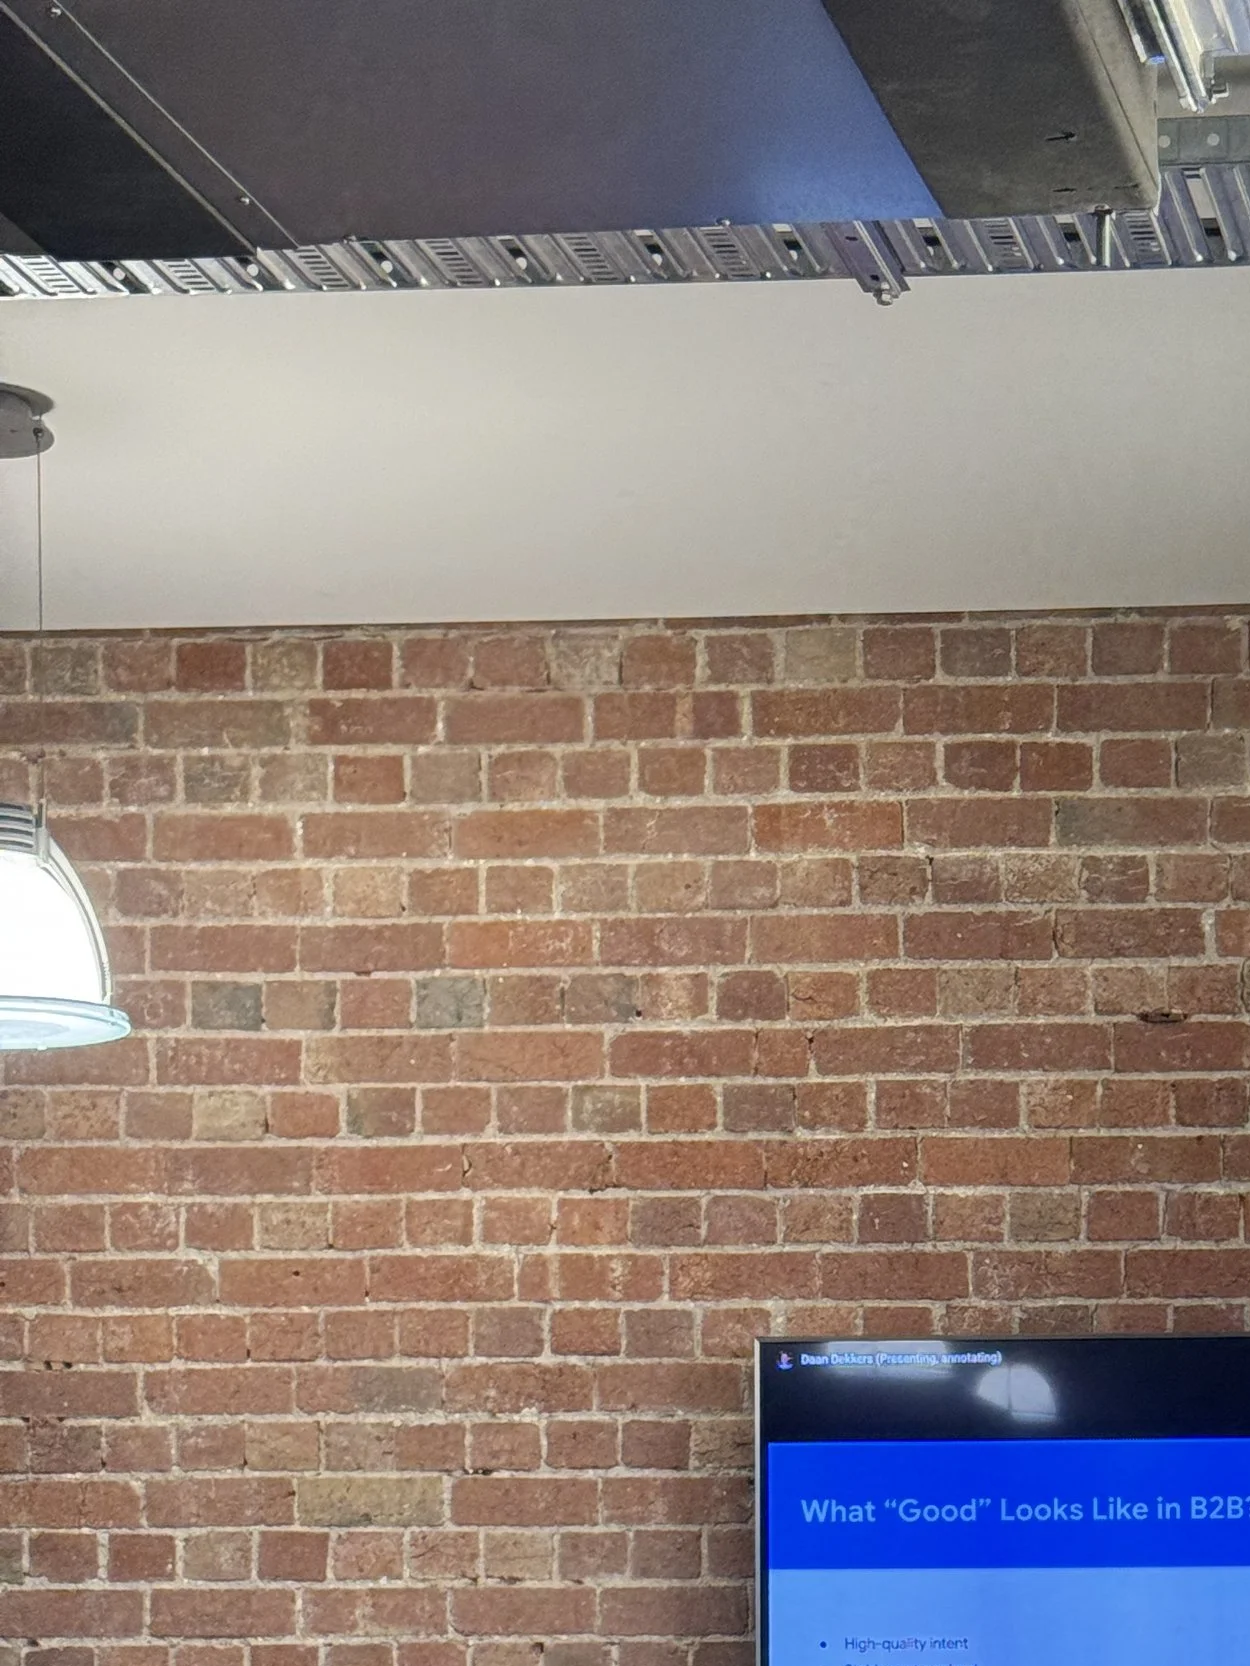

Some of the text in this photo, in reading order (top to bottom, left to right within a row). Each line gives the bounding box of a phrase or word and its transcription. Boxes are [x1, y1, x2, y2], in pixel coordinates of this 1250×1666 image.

[800, 1353, 828, 1365] Daan
[830, 1352, 873, 1365] Dekkers
[942, 1350, 1003, 1367] annotating)
[801, 1498, 876, 1523] What
[884, 1497, 992, 1522] “Good”
[999, 1496, 1084, 1522] Looks
[1092, 1496, 1149, 1521] Like
[1156, 1495, 1181, 1521] in
[844, 1637, 969, 1653] High-quality intent
